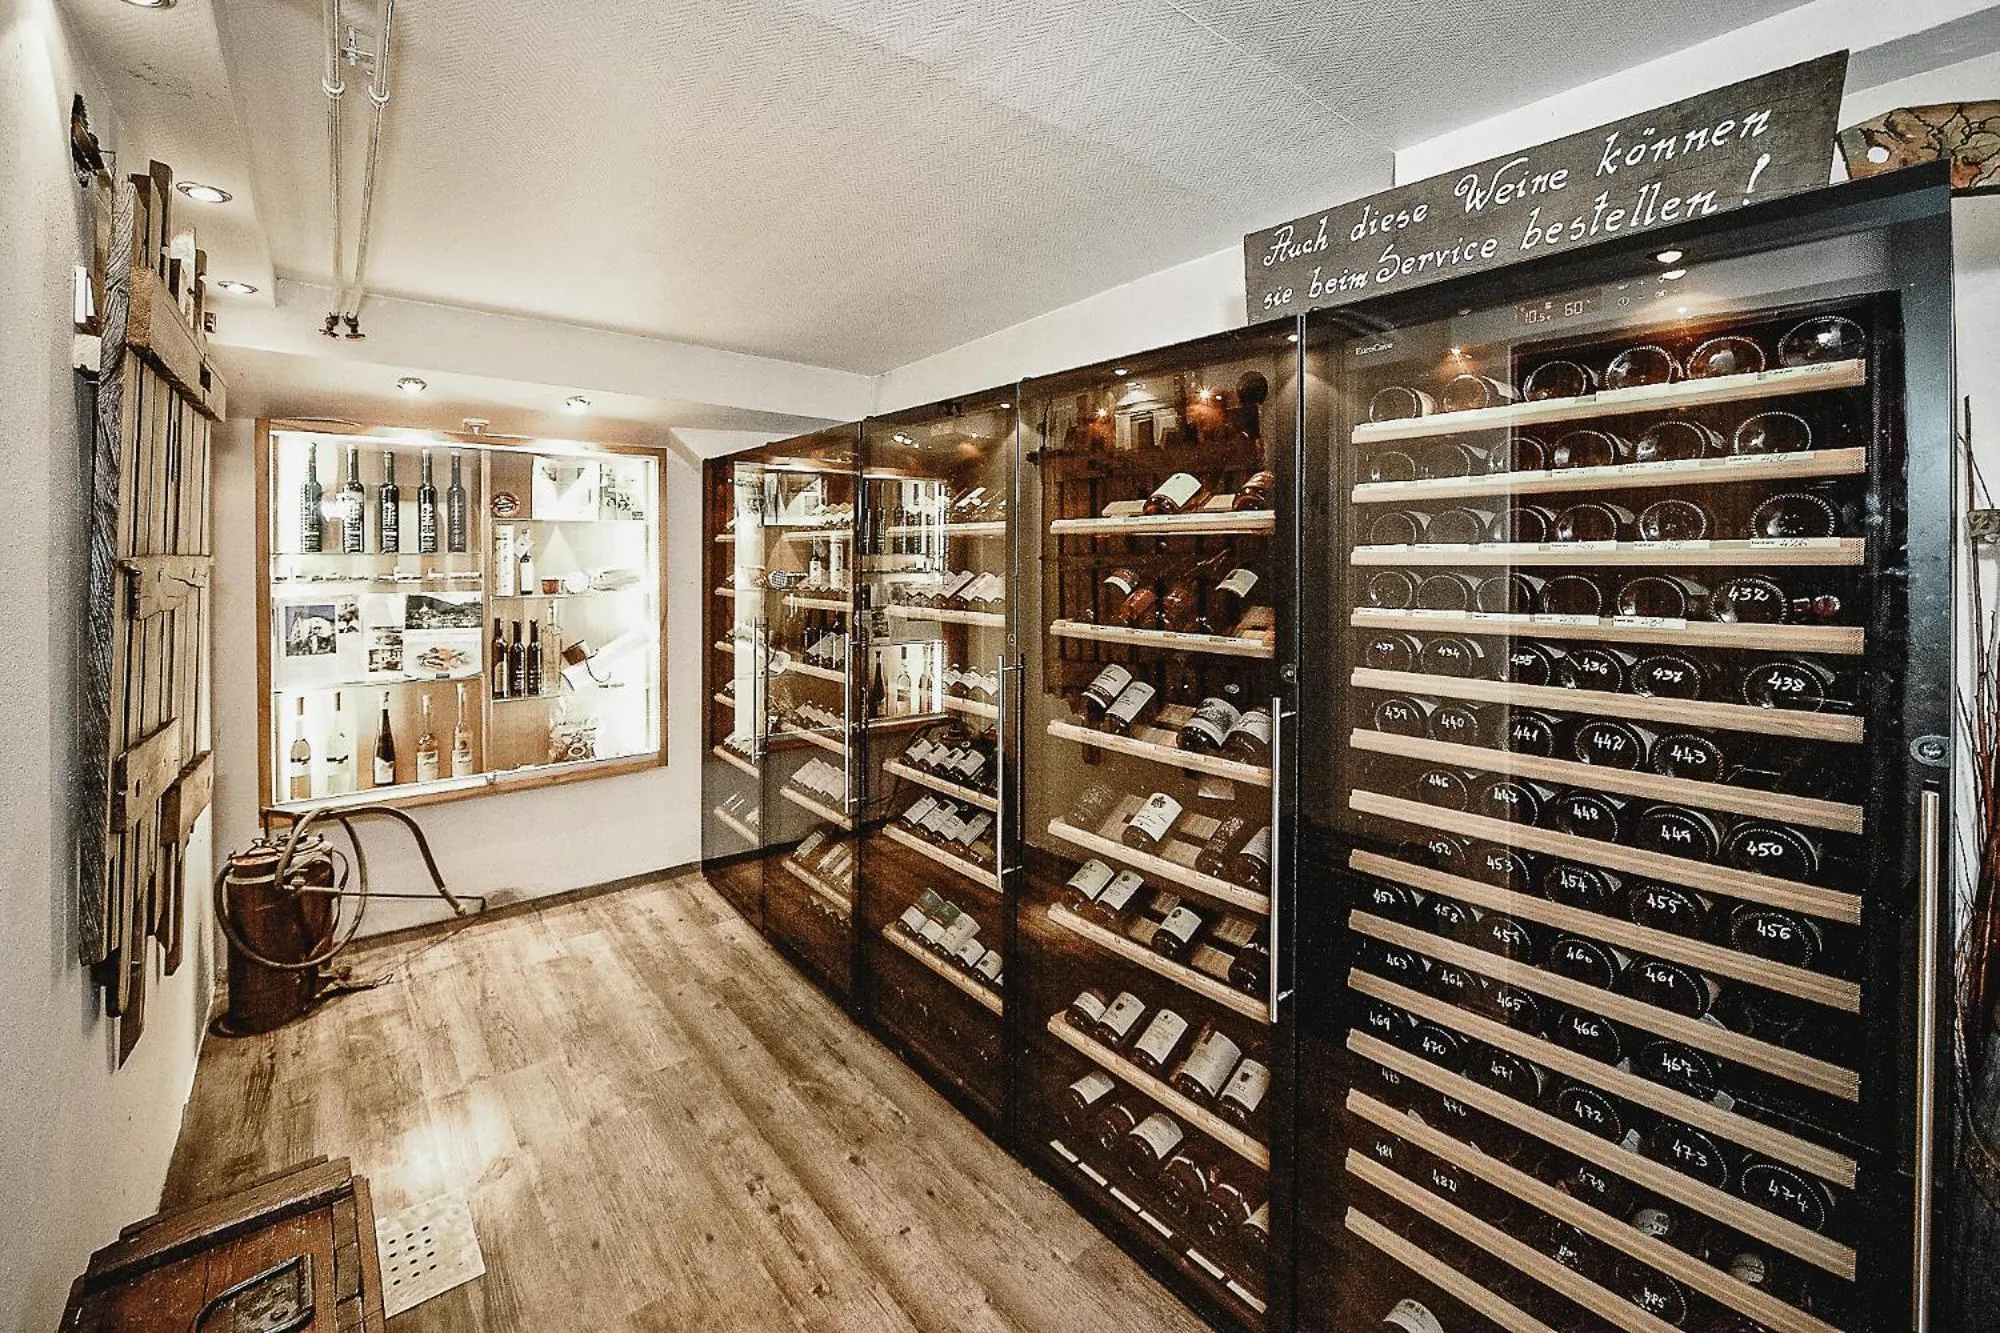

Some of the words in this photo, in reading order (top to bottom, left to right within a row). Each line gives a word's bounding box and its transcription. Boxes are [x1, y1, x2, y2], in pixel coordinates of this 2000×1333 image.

[1263, 214, 1328, 267] Auch
[1350, 203, 1428, 242] diese
[1454, 157, 1569, 213] Weine
[1596, 109, 1772, 176] können
[1263, 286, 1293, 310] sie
[1308, 266, 1369, 298] beim
[1375, 236, 1498, 282] Service
[1519, 181, 1718, 251] bestellen
[1564, 300, 1583, 317] 60
[1727, 583, 1772, 602] 432
[1510, 653, 1537, 666] 435
[1582, 654, 1610, 675] 436
[1767, 669, 1809, 692] 438
[1382, 703, 1409, 721] 439
[1441, 713, 1465, 730] 440
[1512, 722, 1541, 742] 441
[1670, 743, 1707, 764] 443
[1746, 840, 1784, 857] 450
[1486, 853, 1514, 873] 453
[1560, 869, 1587, 893] 454
[1433, 903, 1459, 923] 458
[1646, 892, 1681, 914] 455
[1757, 919, 1792, 940] 456
[1386, 953, 1408, 970] 463
[1565, 945, 1593, 964] 460
[1645, 966, 1675, 988] 461
[1496, 991, 1527, 1011] 465
[1369, 1010, 1390, 1031] 469
[1573, 1017, 1599, 1037] 466
[1422, 1036, 1446, 1055] 470
[1662, 1052, 1699, 1078] 467
[1574, 1100, 1604, 1124] 472
[1672, 1138, 1709, 1168] 473
